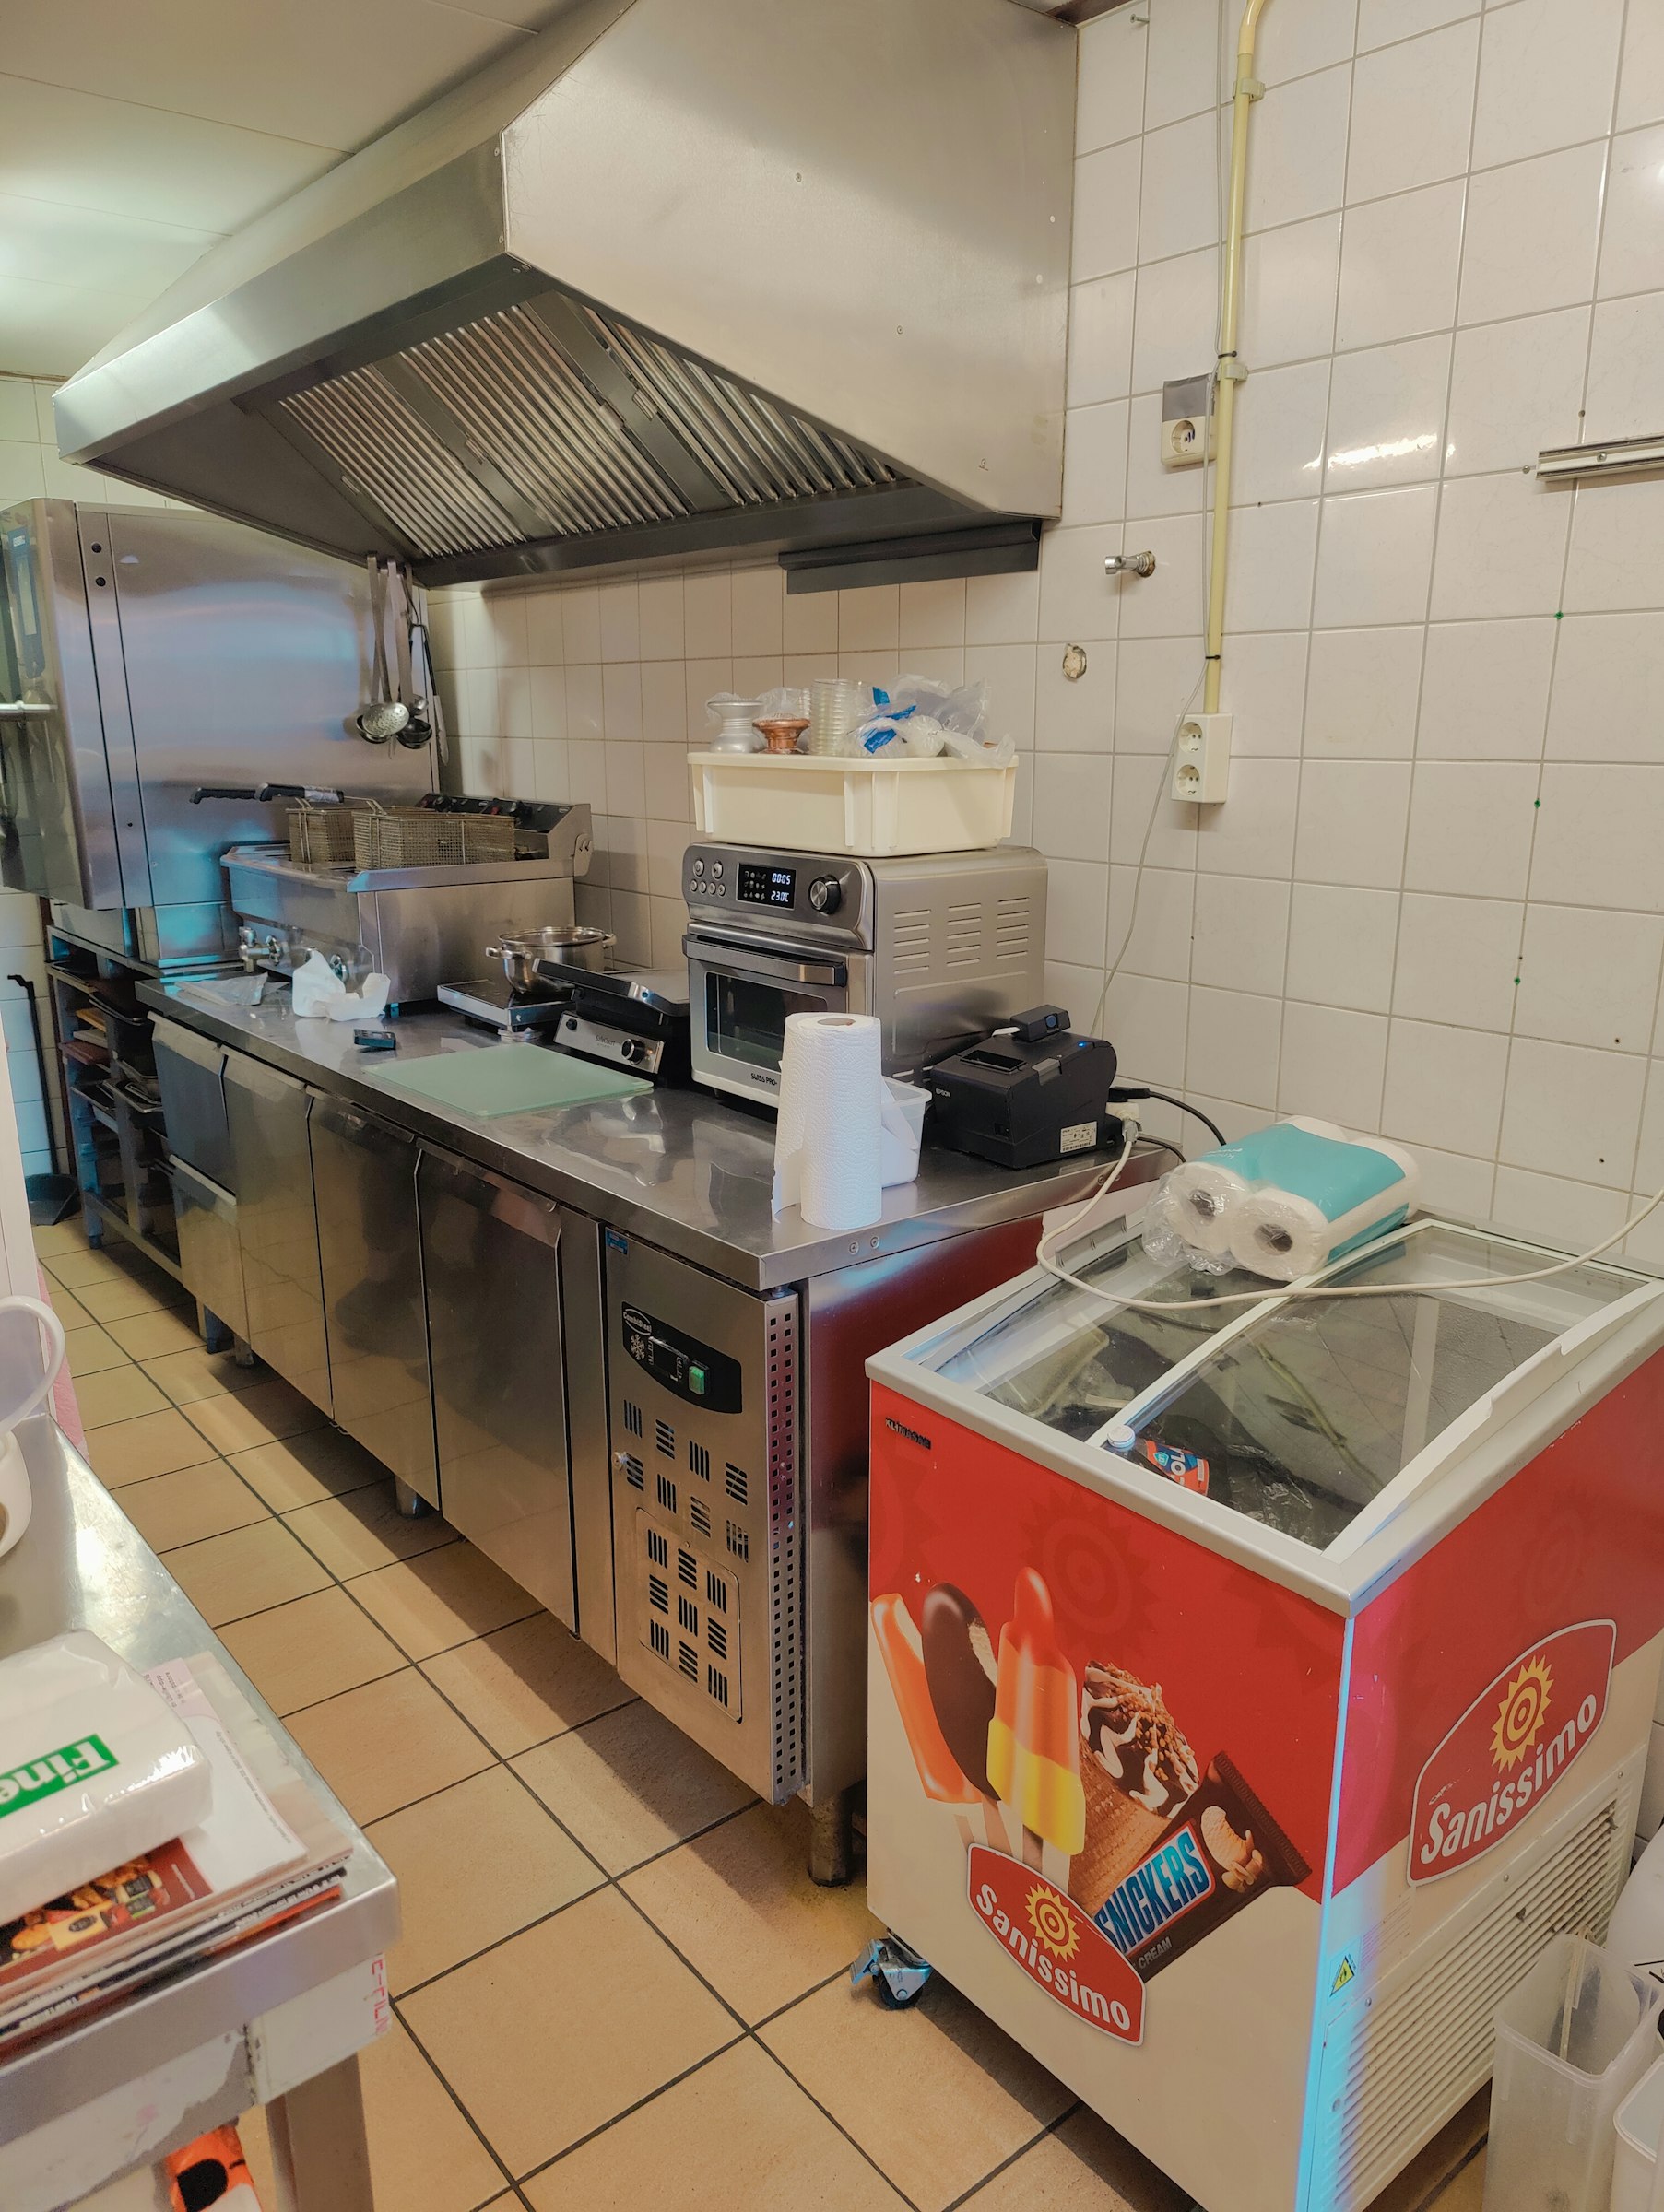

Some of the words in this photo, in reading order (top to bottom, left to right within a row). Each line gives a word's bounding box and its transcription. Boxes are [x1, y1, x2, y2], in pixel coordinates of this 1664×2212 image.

[936, 1088, 951, 1098] EPSON
[622, 1311, 653, 1333] CombiSteel
[1419, 1692, 1598, 1865] Sanissimo
[1094, 1832, 1210, 1953] SNICKERS
[975, 1881, 1132, 2031] Sanissimo
[1138, 1936, 1173, 1970] CREAM
